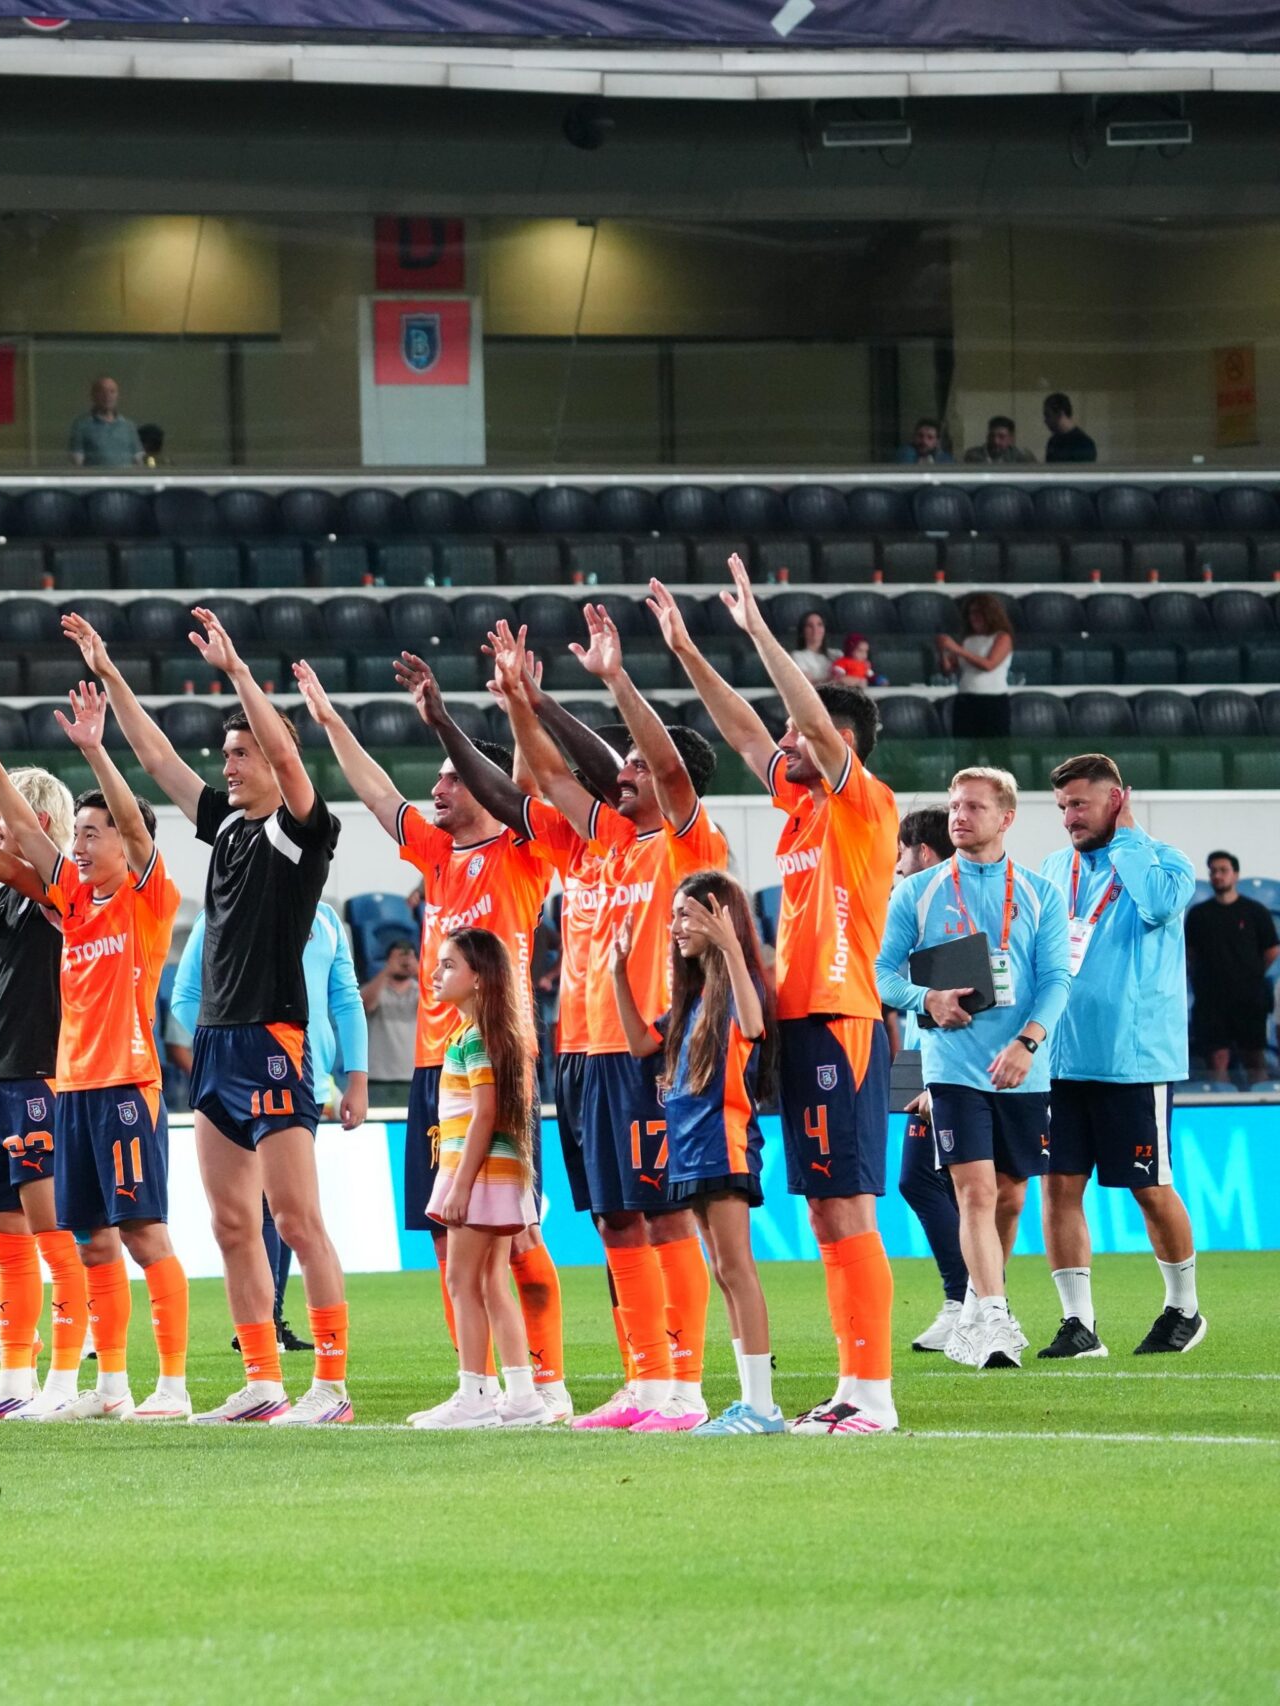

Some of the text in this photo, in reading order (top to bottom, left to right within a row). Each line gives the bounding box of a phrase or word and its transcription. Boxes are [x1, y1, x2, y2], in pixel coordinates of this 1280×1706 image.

[630, 1120, 668, 1169] 17
[804, 1105, 830, 1155] 4
[112, 1137, 144, 1186] 11
